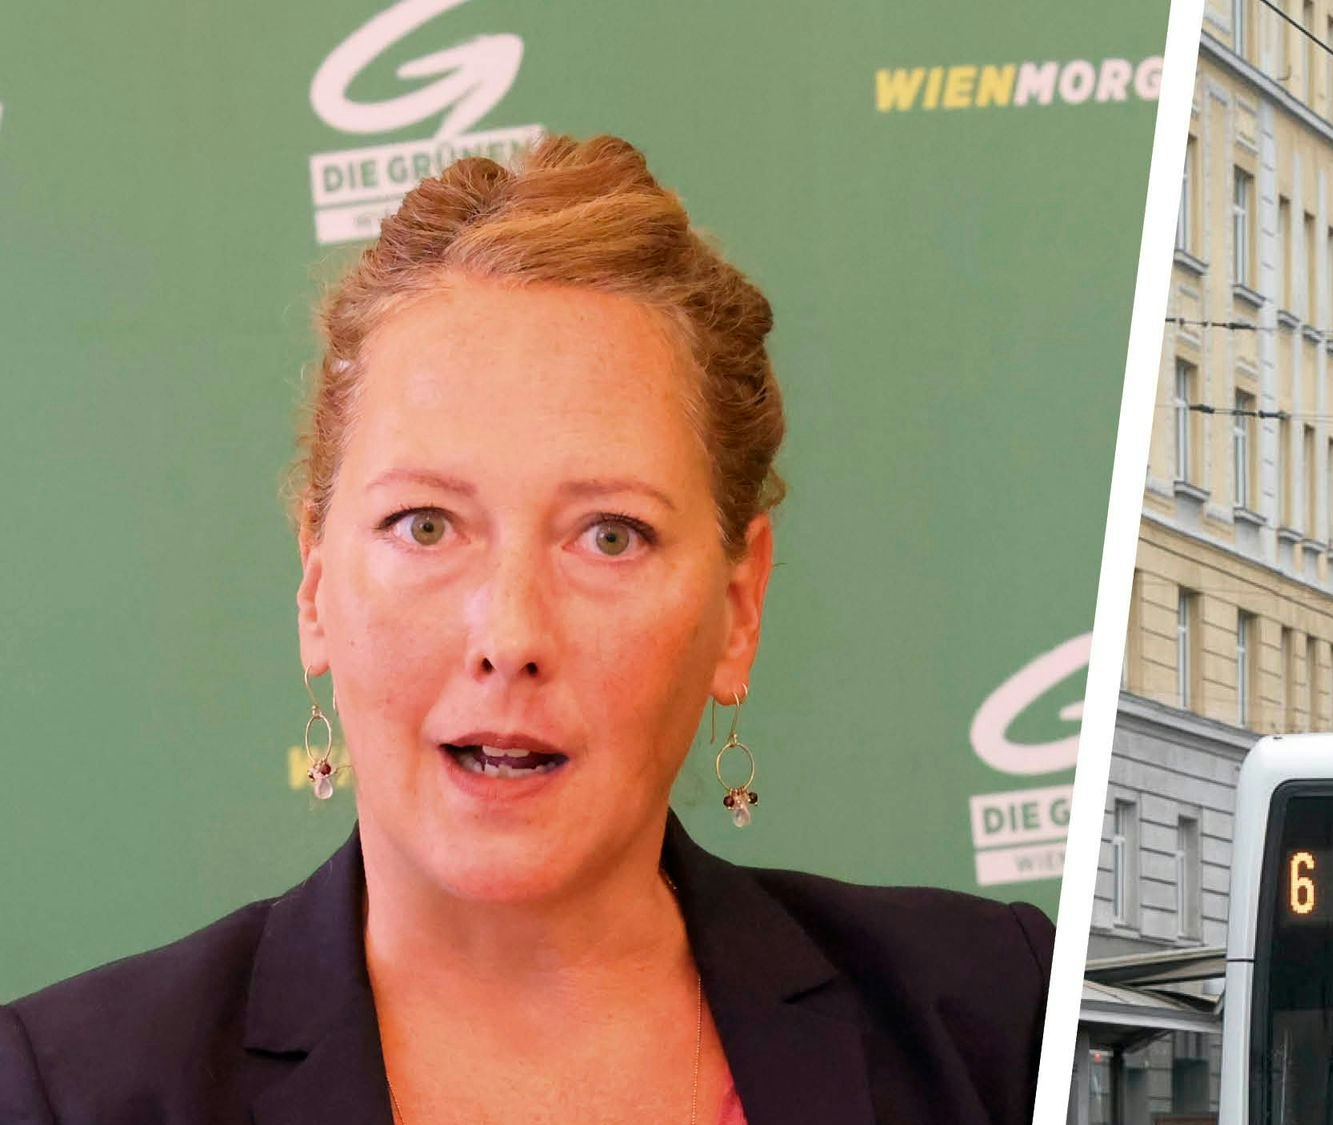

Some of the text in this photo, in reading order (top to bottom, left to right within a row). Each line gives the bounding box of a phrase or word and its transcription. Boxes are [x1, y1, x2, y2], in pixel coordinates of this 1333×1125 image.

[875, 55, 1164, 112] WIENMORG
[323, 160, 379, 192] DIE
[983, 801, 1042, 835] DIE
[1289, 851, 1316, 914] 6
